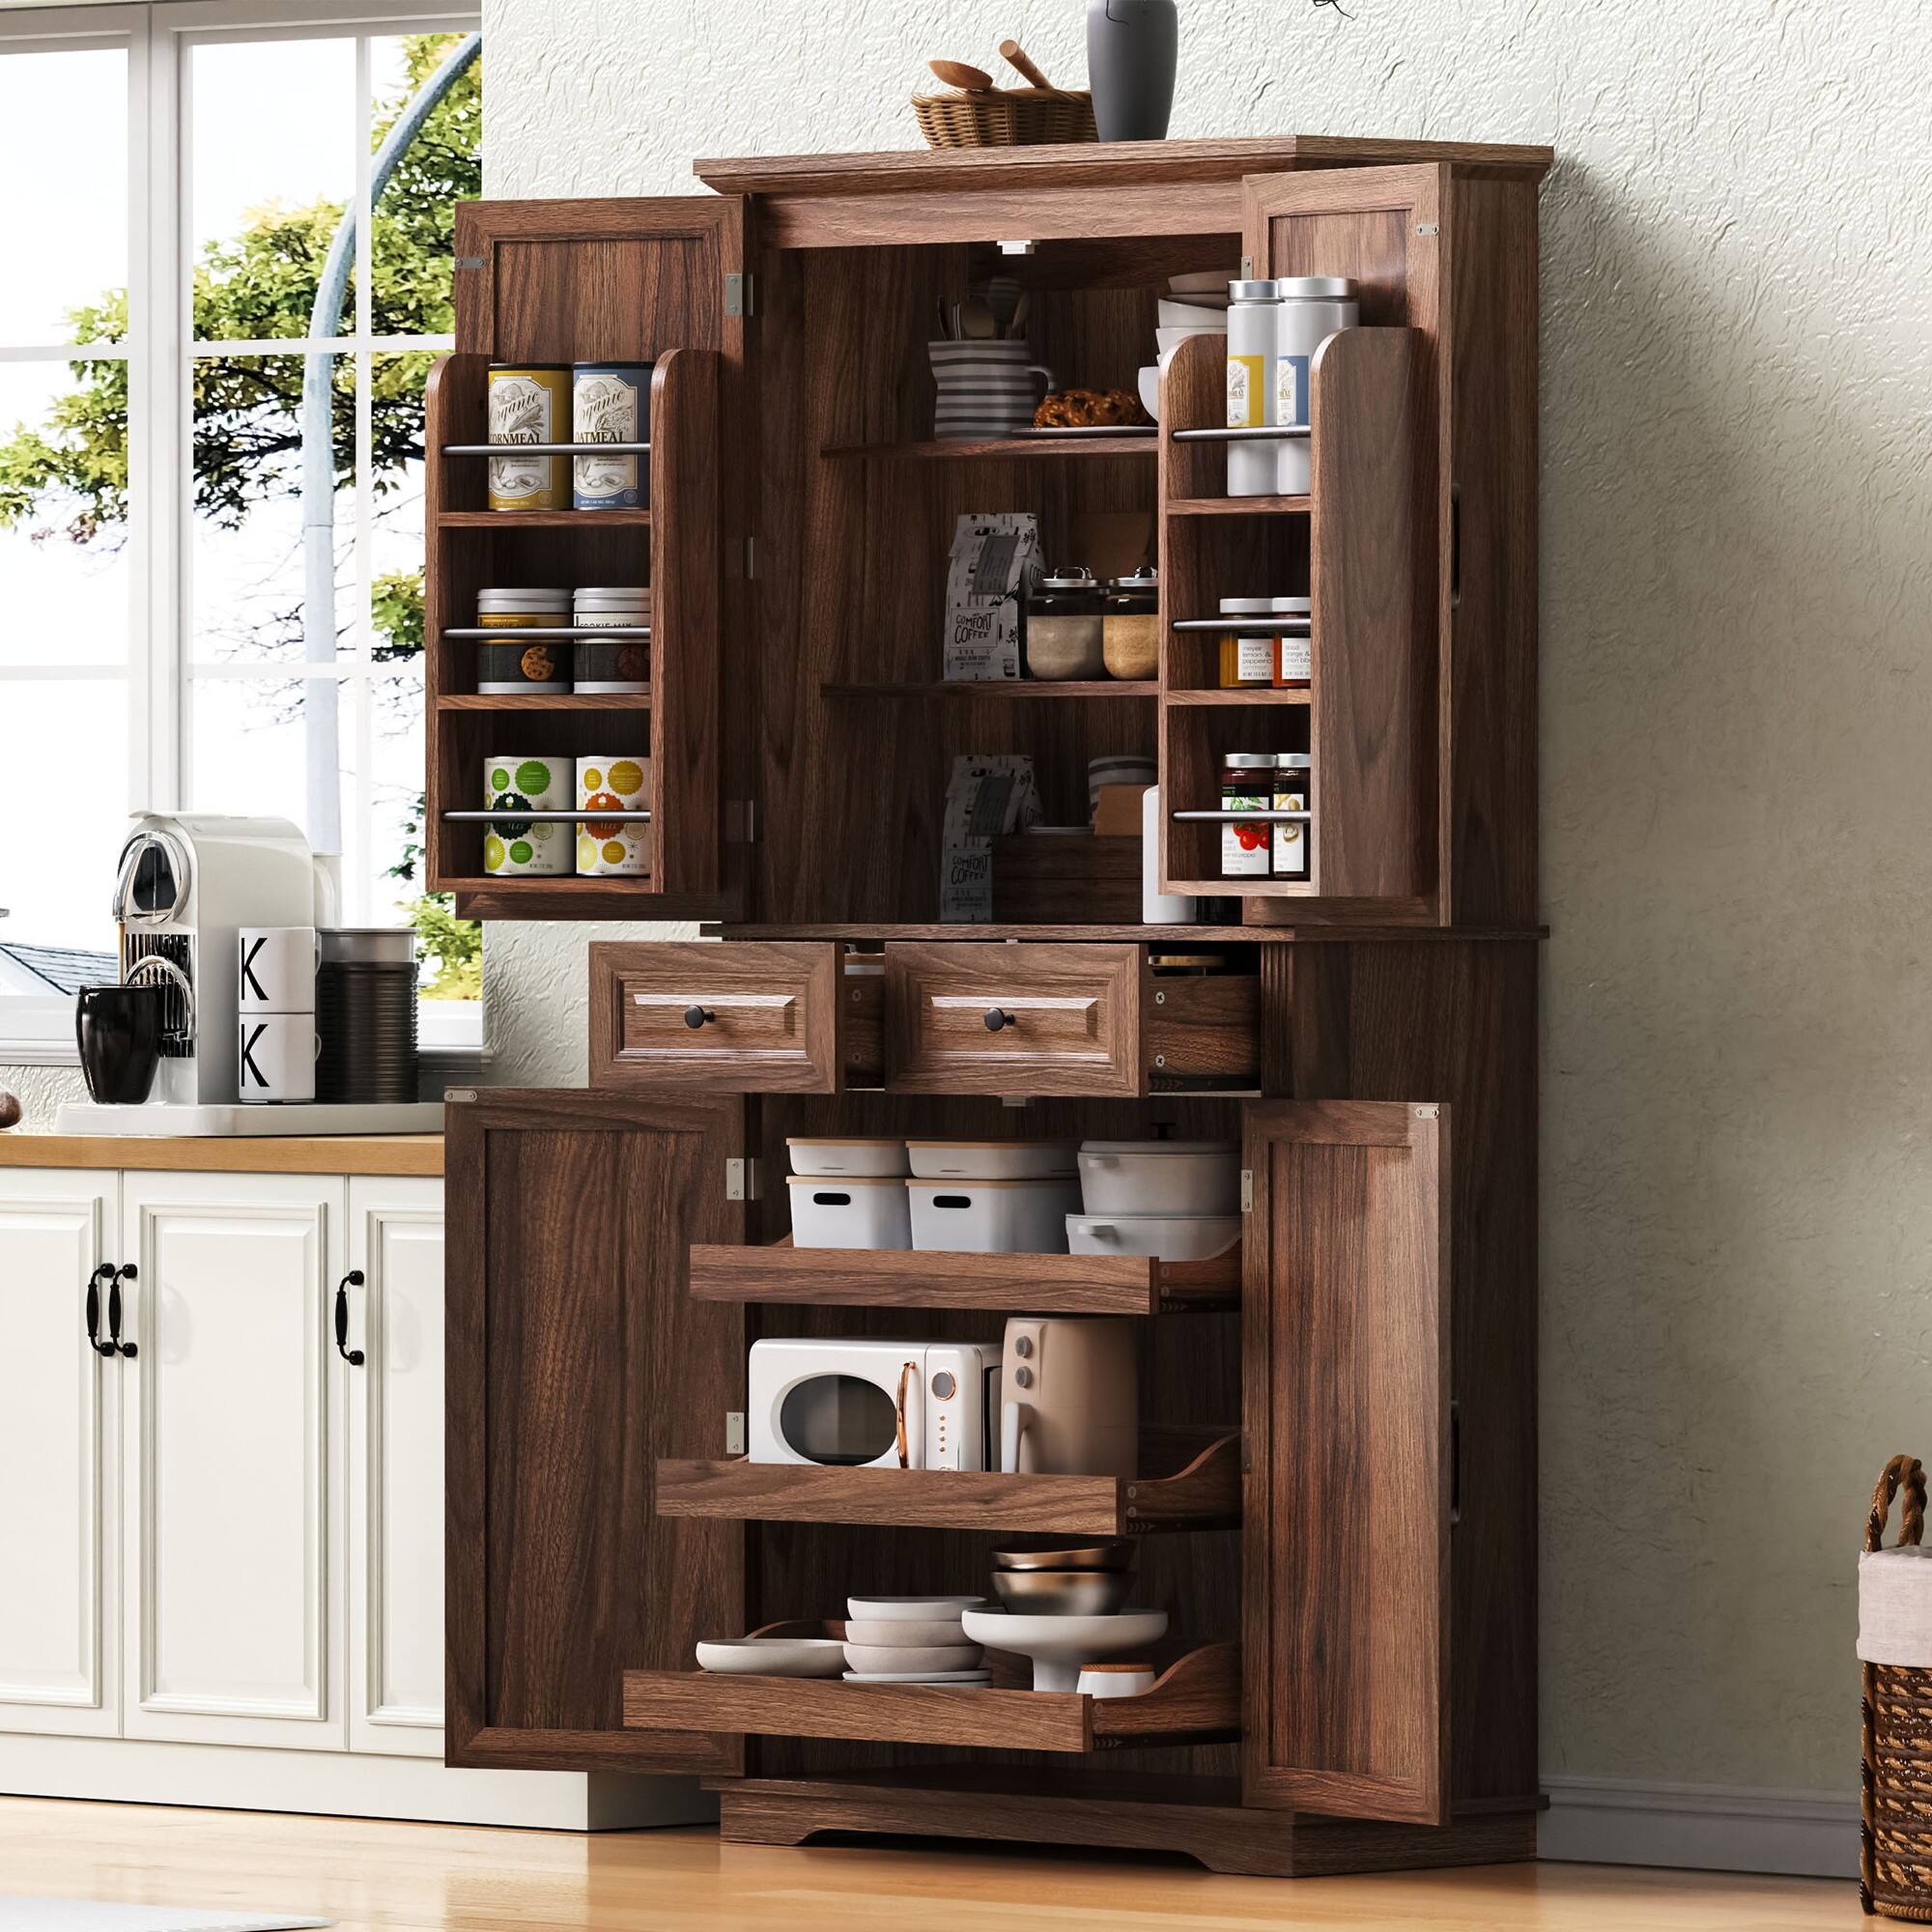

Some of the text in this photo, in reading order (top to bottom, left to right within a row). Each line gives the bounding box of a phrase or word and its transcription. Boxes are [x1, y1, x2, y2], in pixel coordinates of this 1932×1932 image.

[954, 624, 990, 644] COFFEE
[955, 611, 996, 631] COMFORT
[242, 938, 270, 1001] K
[242, 1024, 270, 1088] K
